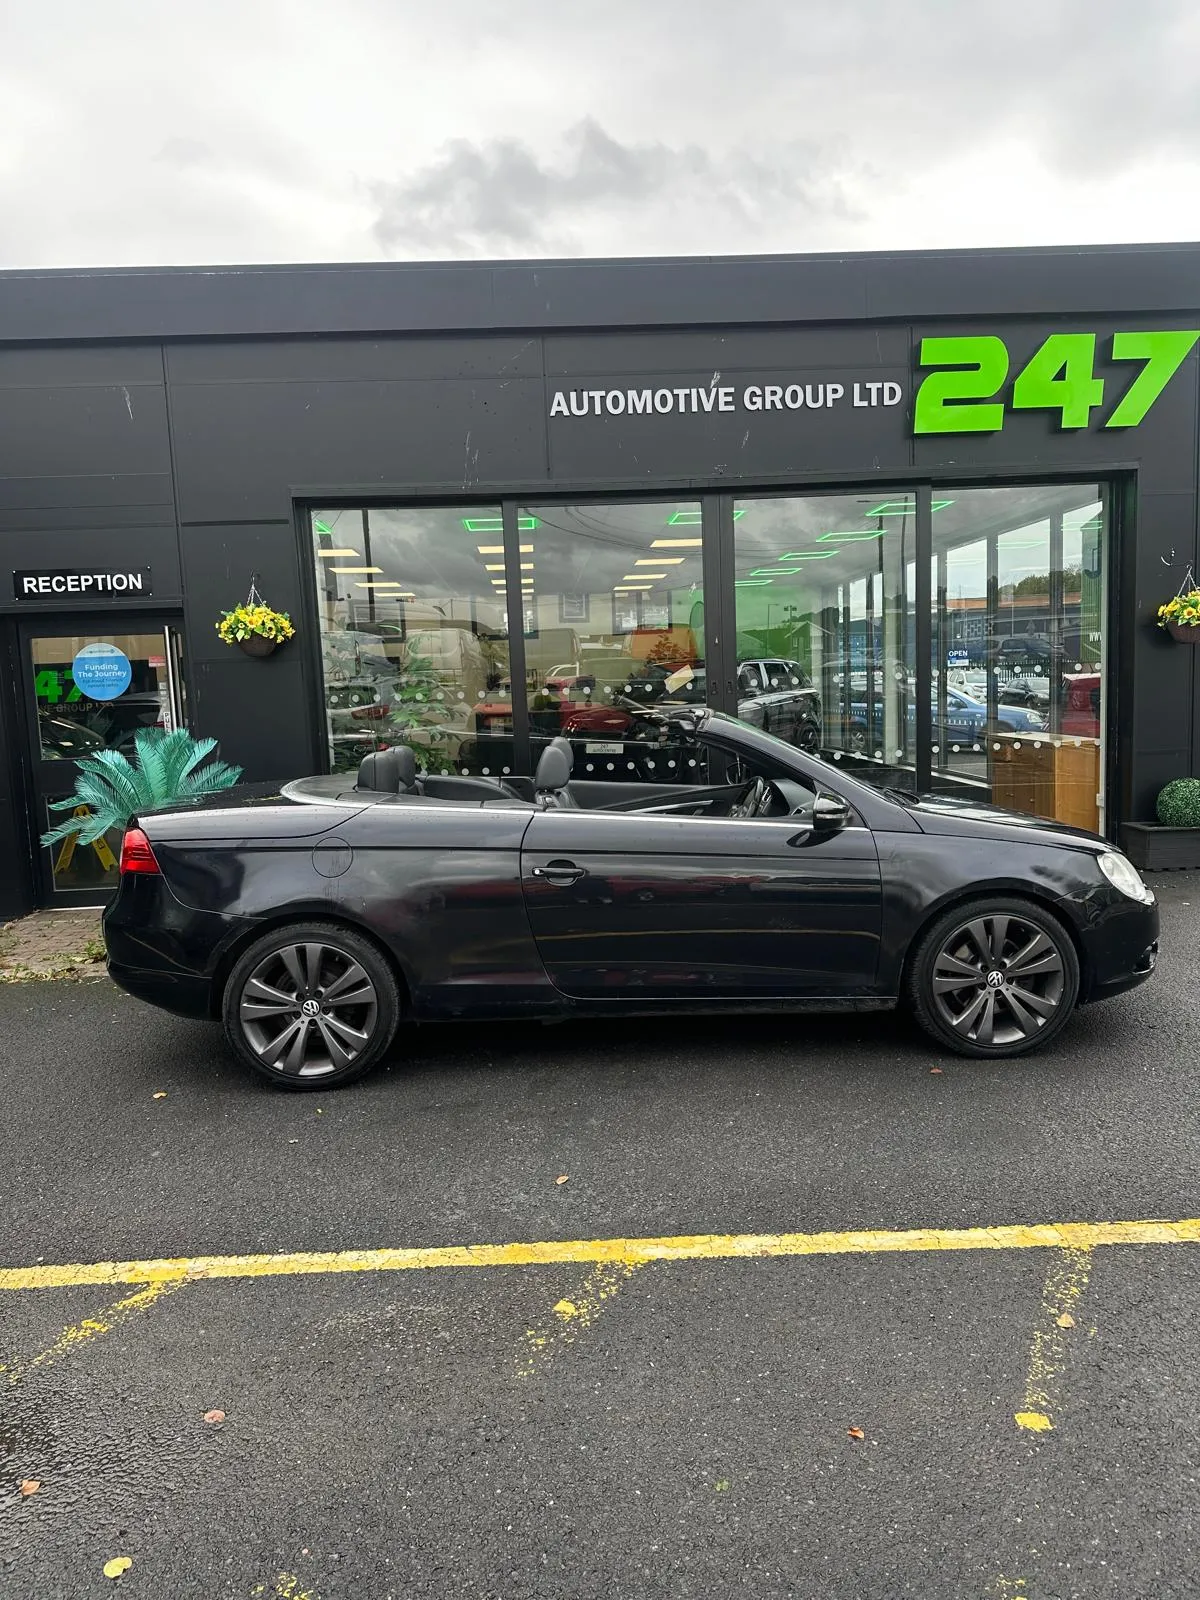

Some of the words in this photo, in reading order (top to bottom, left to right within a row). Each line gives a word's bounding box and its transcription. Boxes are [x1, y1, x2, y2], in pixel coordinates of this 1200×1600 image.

[914, 330, 1200, 435] 247
[550, 386, 735, 417] AUTOMOTIVE
[743, 383, 844, 411] GROUP
[853, 381, 902, 407] LTD
[23, 573, 143, 594] RECEPTION
[95, 670, 127, 678] Journey
